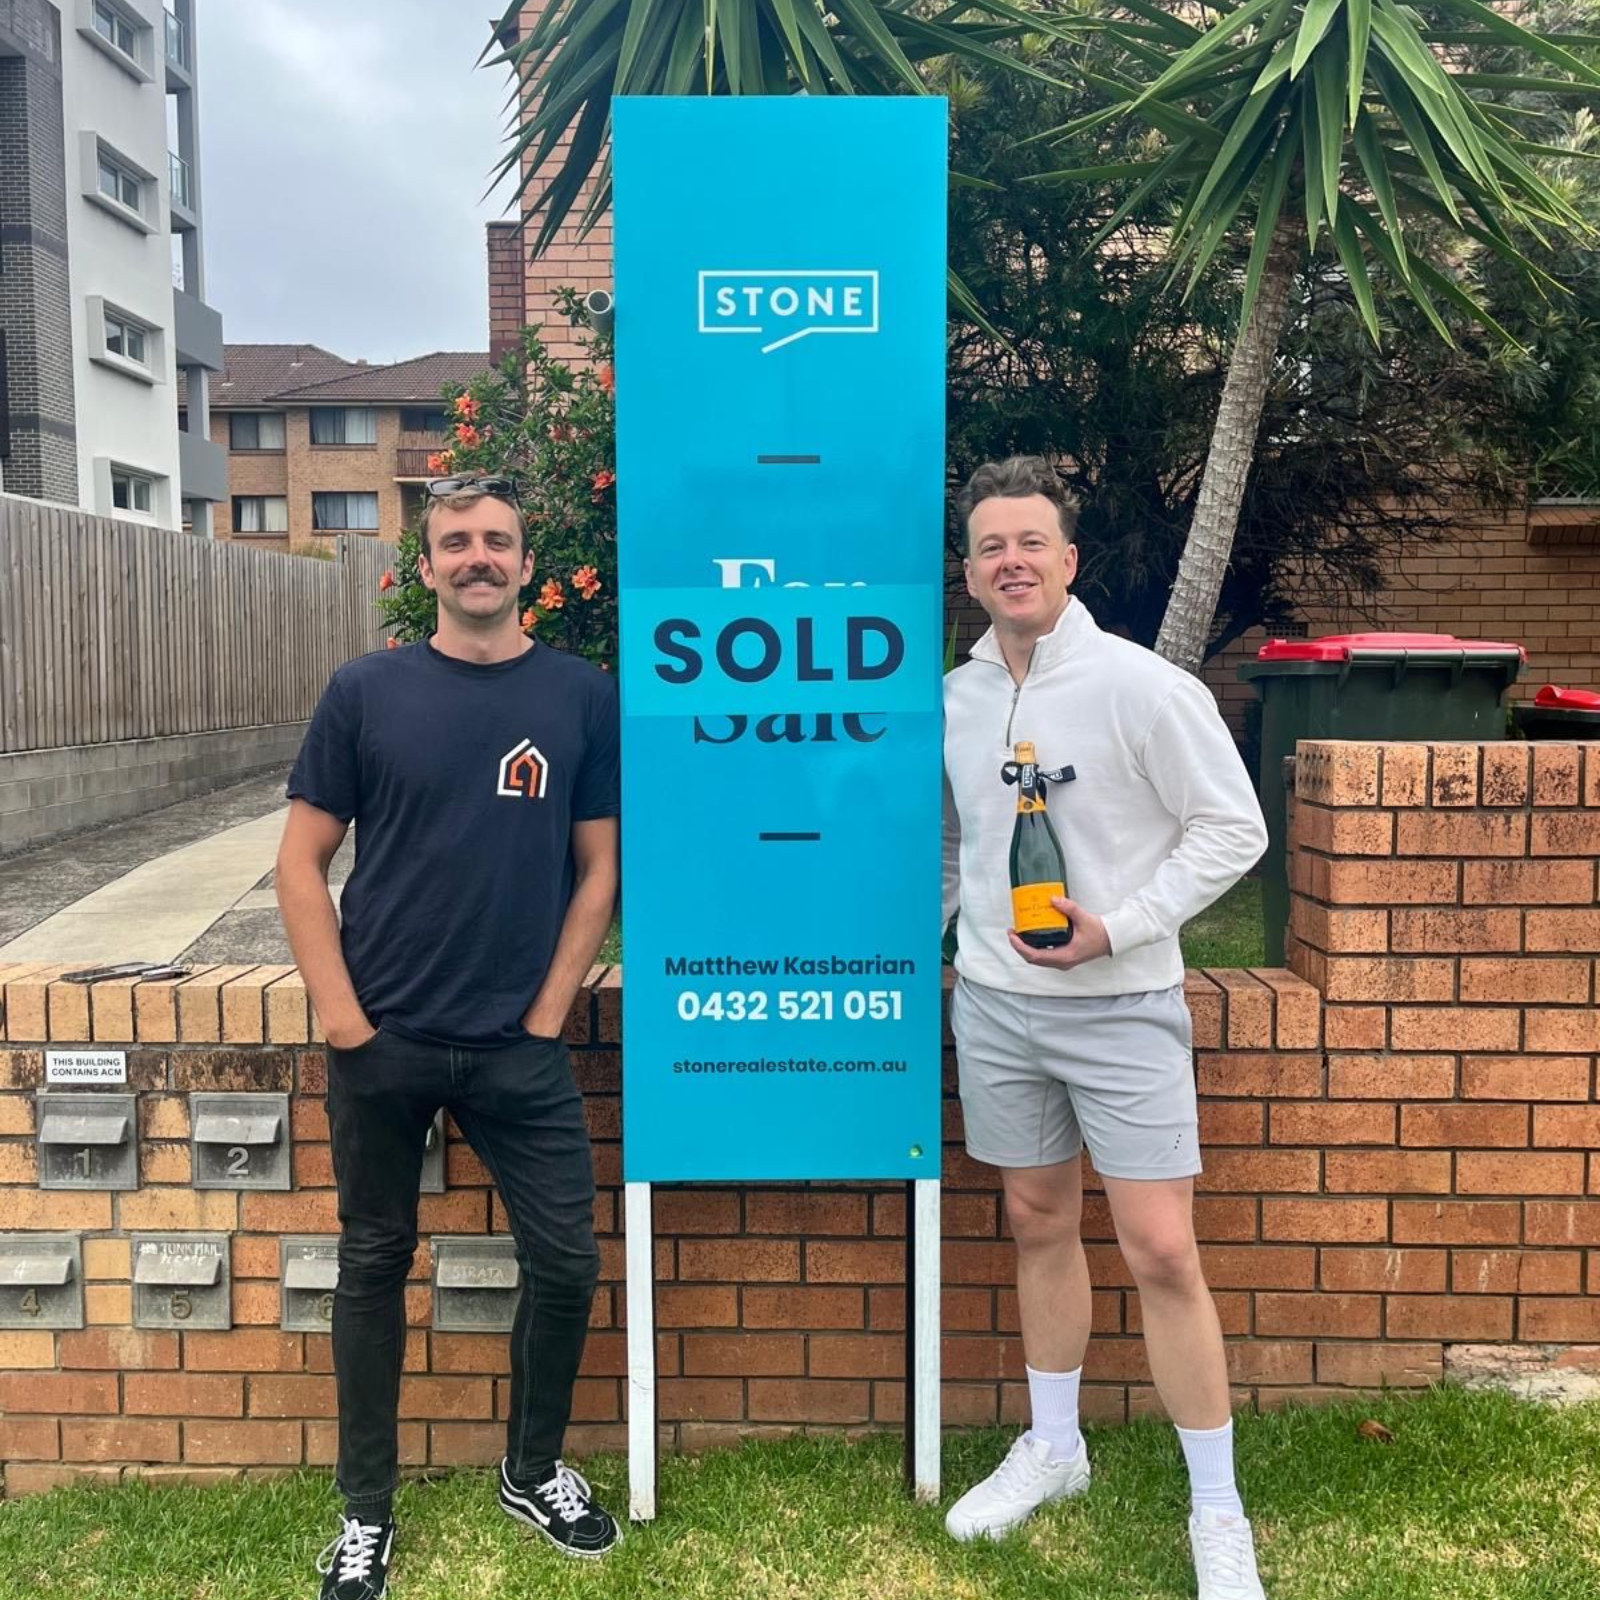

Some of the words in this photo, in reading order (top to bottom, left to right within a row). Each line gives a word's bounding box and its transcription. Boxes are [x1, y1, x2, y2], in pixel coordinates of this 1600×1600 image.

[716, 286, 862, 316] STONE
[653, 616, 905, 684] SOLD
[665, 956, 779, 976] Matthew
[784, 954, 916, 976] Kasbarian
[677, 991, 768, 1021] 0432
[779, 990, 833, 1020] 521
[843, 990, 902, 1020] 051
[51, 1068, 99, 1076] CONTAINS
[100, 1068, 122, 1076] ACM
[53, 1058, 74, 1066] THIS
[76, 1058, 120, 1066] BUILDING
[672, 1058, 908, 1074] stonerealestate.com.au
[74, 1148, 90, 1177] 1
[227, 1146, 249, 1175] 2
[160, 1242, 193, 1256] JUNK
[452, 1264, 504, 1281] STRATA
[20, 1287, 41, 1318] 4
[171, 1290, 193, 1320] 5
